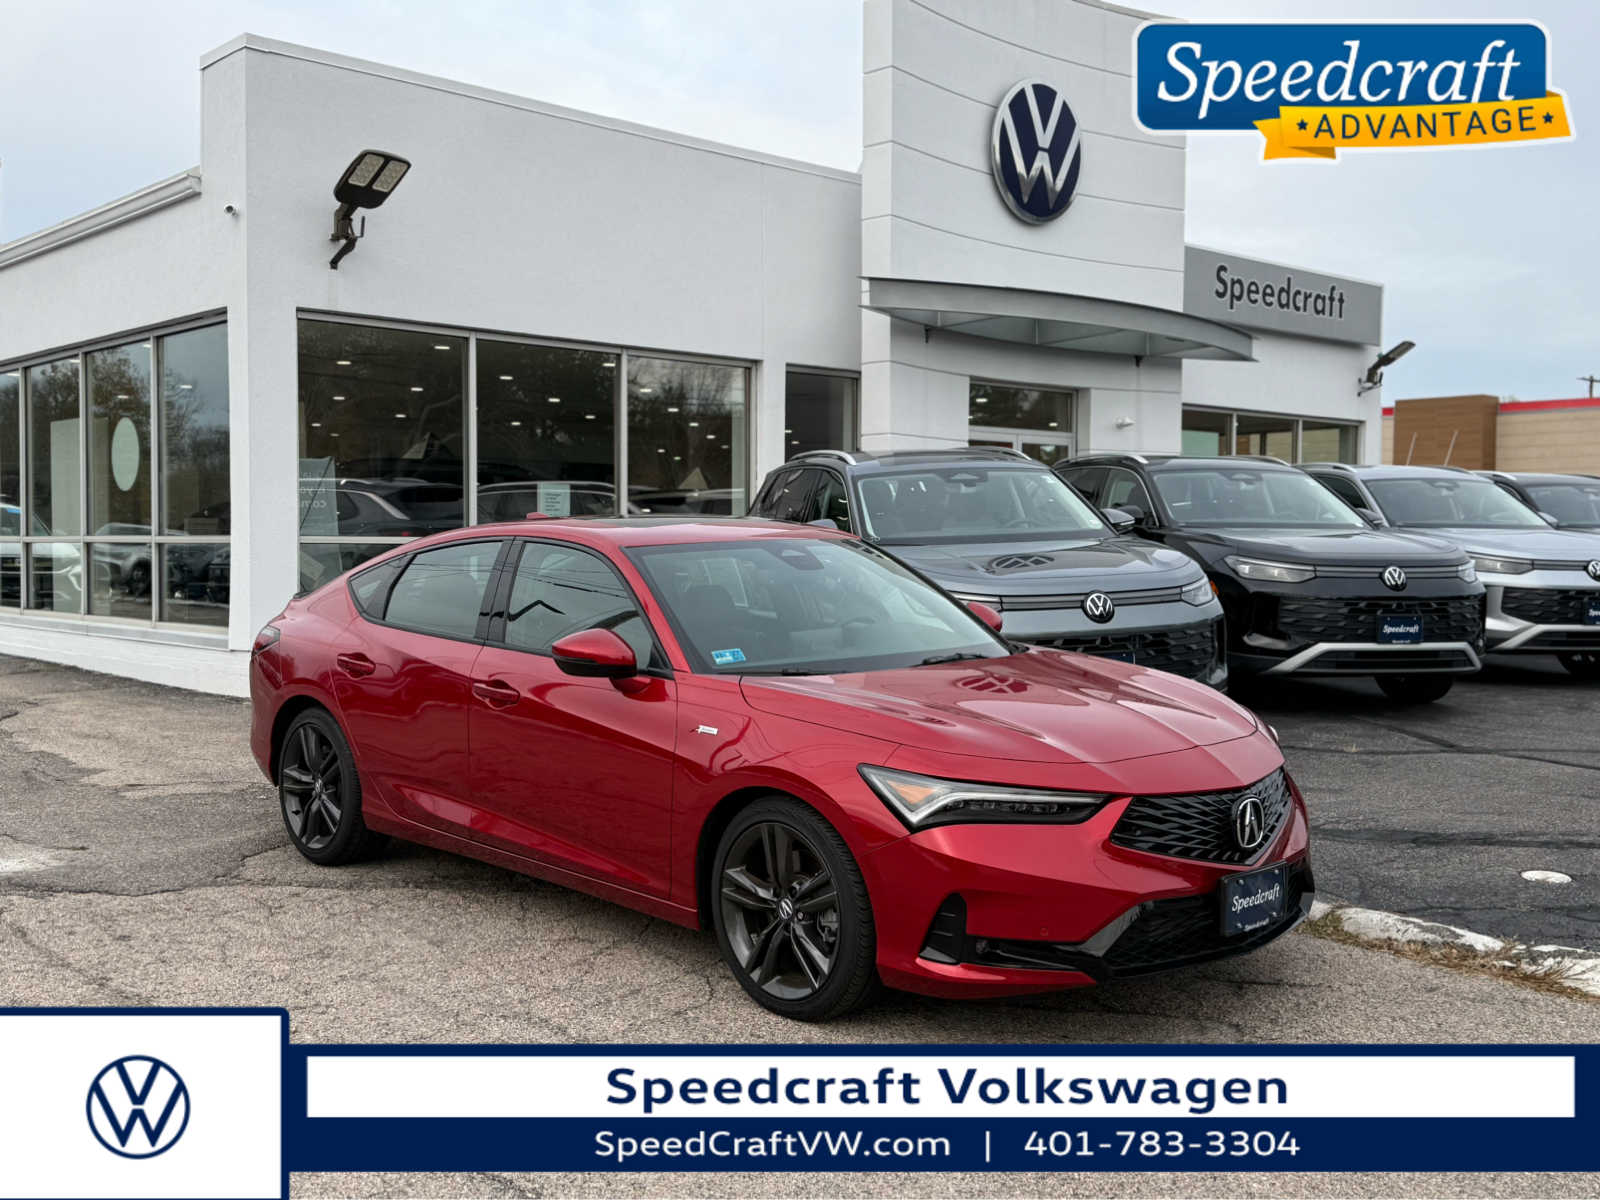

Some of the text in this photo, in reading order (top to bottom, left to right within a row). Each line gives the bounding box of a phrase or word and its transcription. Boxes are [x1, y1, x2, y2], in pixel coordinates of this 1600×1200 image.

[1214, 264, 1345, 319] Speedcraft
[1383, 624, 1419, 634] Speedcraft
[1231, 882, 1280, 914] Speedcraft
